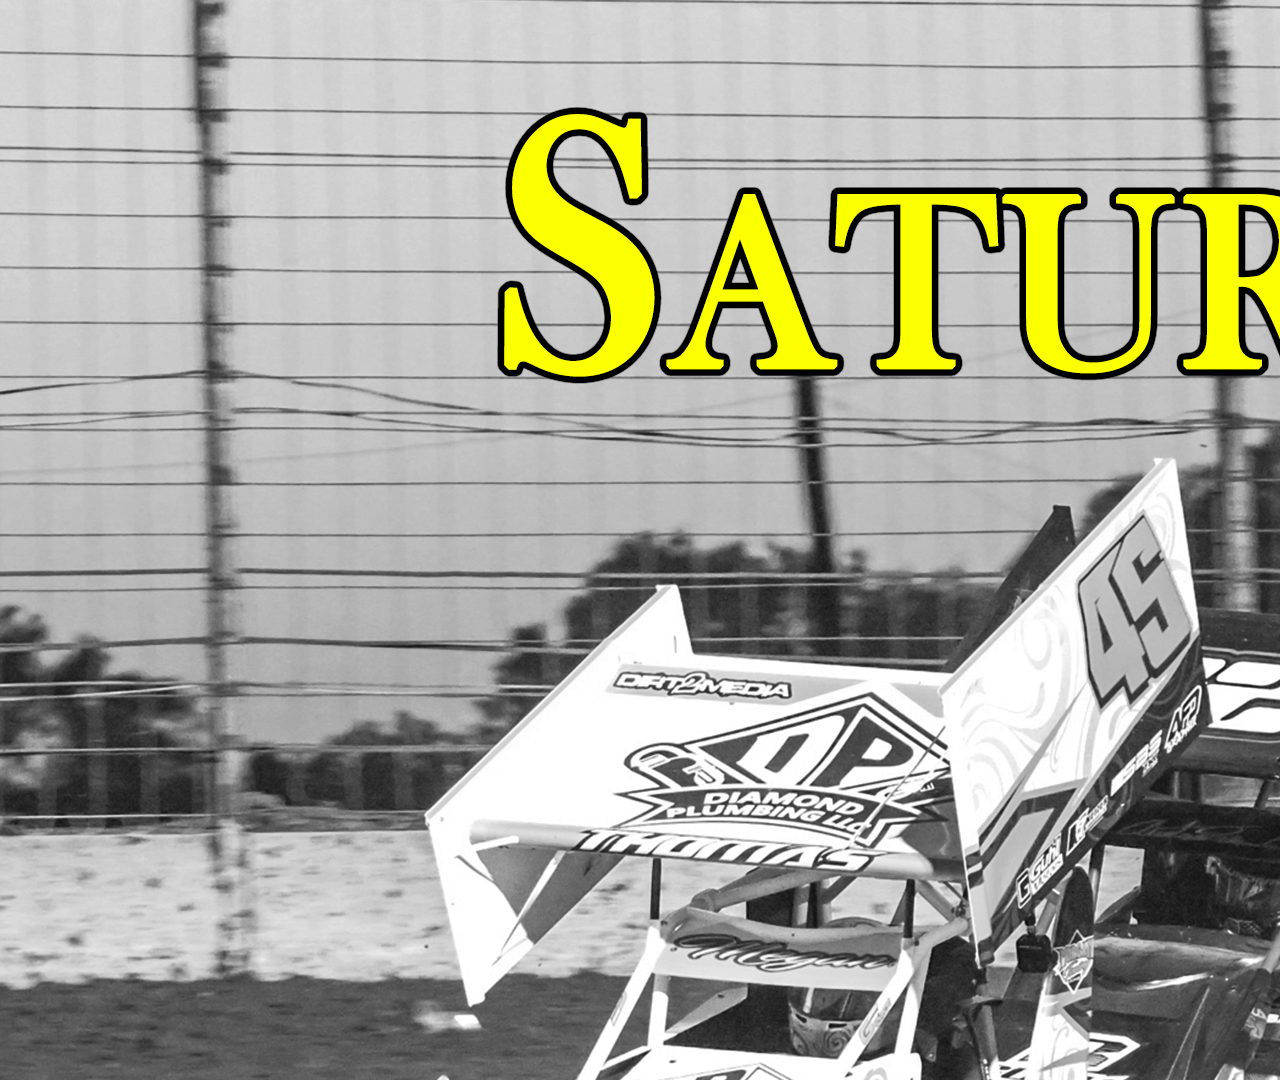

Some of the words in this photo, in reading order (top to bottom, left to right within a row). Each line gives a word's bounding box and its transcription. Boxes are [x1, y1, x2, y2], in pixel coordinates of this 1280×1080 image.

[1078, 515, 1192, 705] 45
[667, 806, 823, 831] PLUMBING
[823, 817, 872, 832] LLC
[702, 791, 866, 815] DIAMOND
[574, 832, 880, 871] THOMAS
